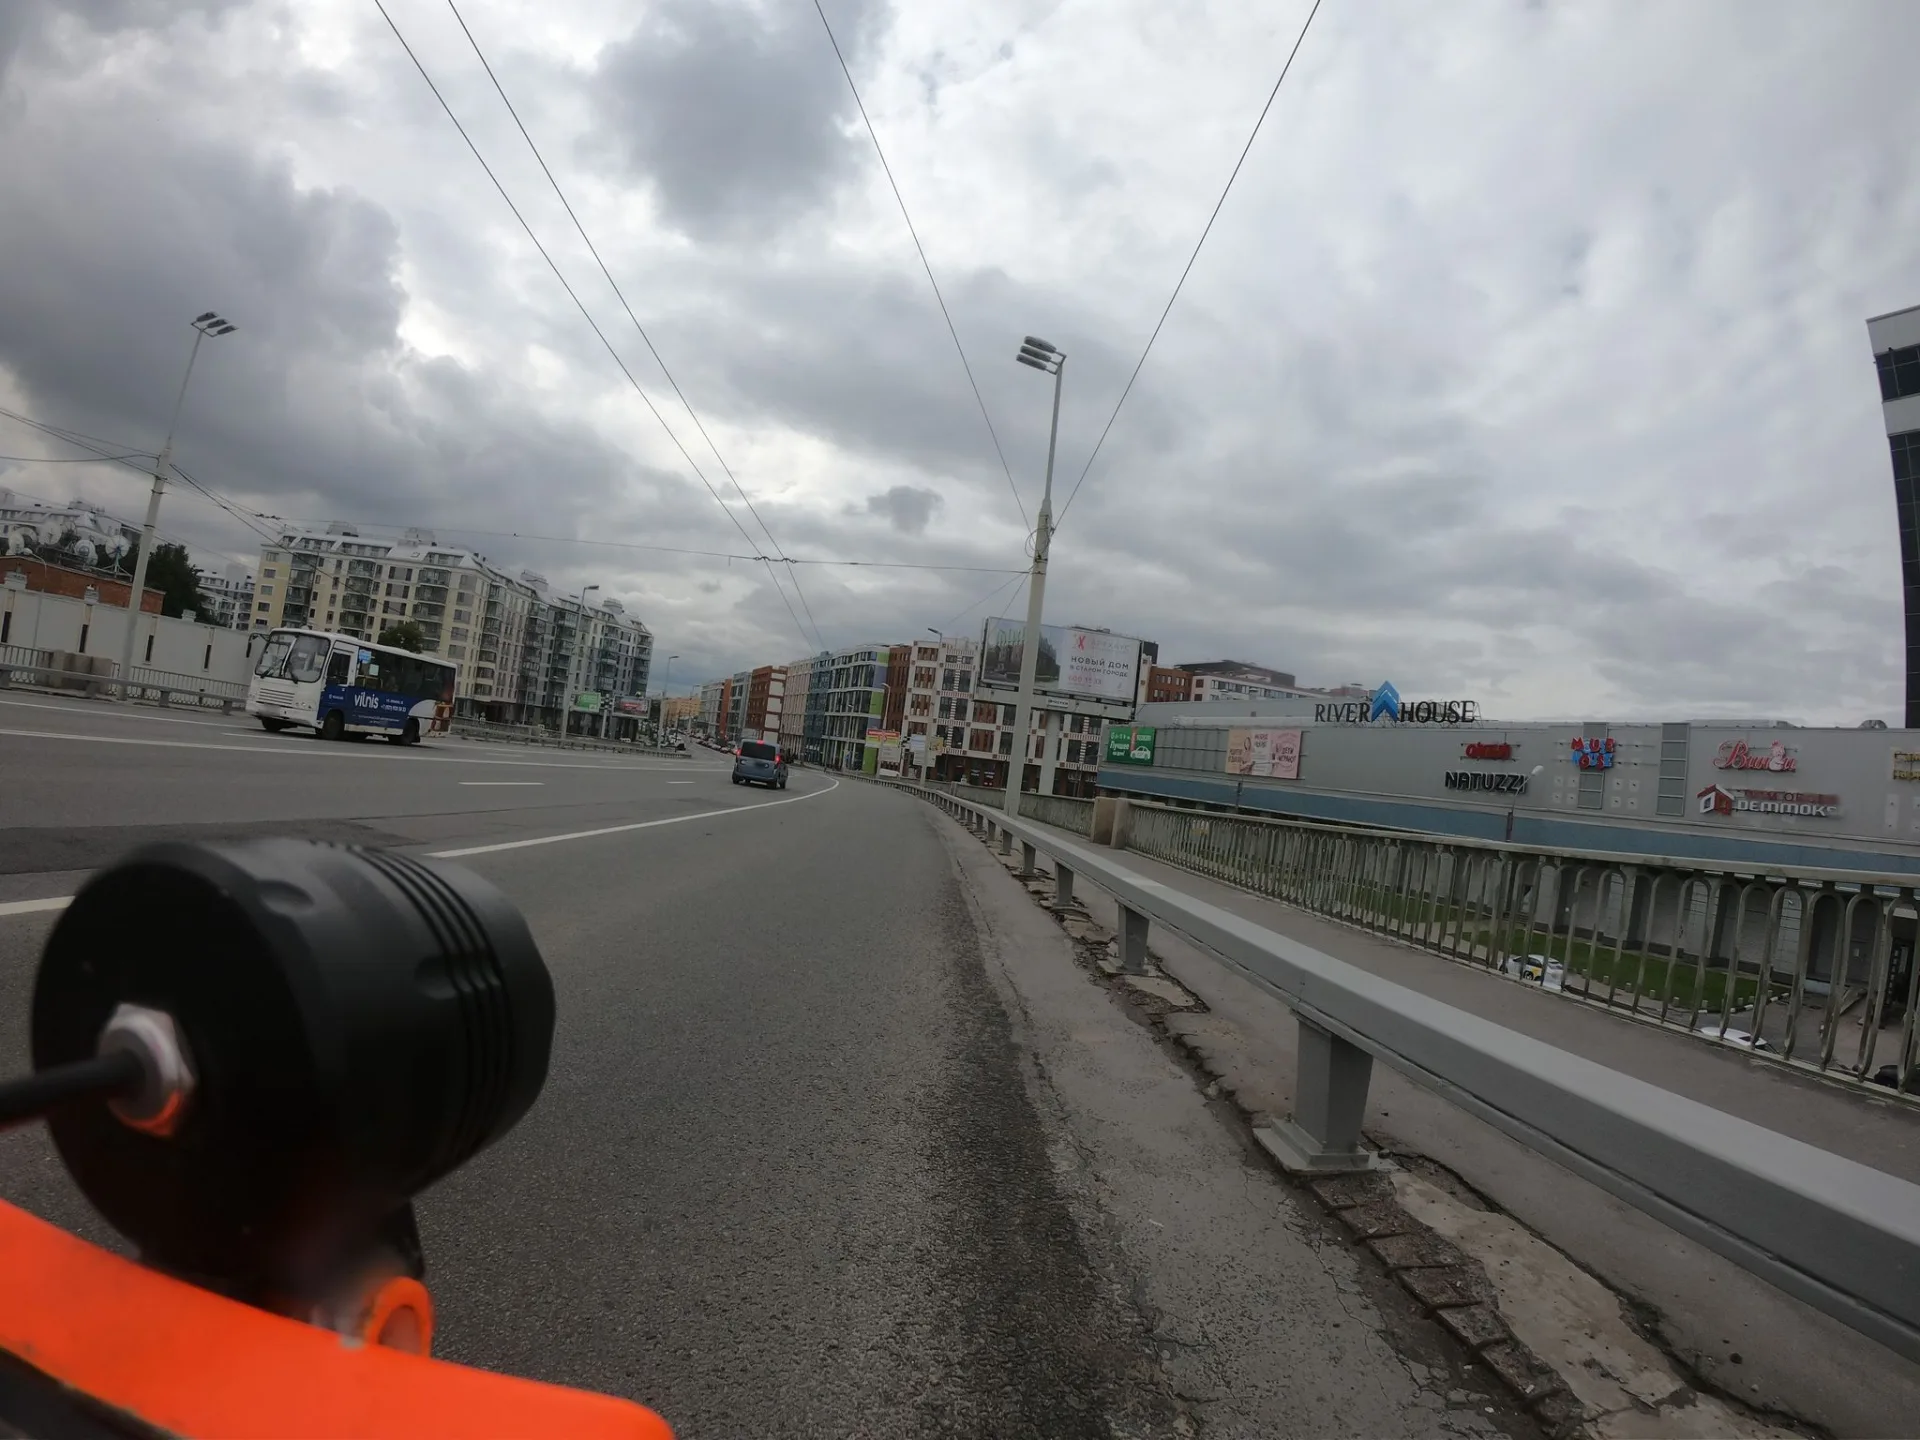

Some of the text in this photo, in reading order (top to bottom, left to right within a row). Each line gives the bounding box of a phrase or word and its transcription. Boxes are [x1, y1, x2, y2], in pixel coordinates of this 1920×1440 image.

[1071, 656, 1129, 670] НОВЫЙ ДОМ
[1314, 700, 1475, 724] RIVER HOUSE
[1444, 770, 1527, 795] NATUZZI
